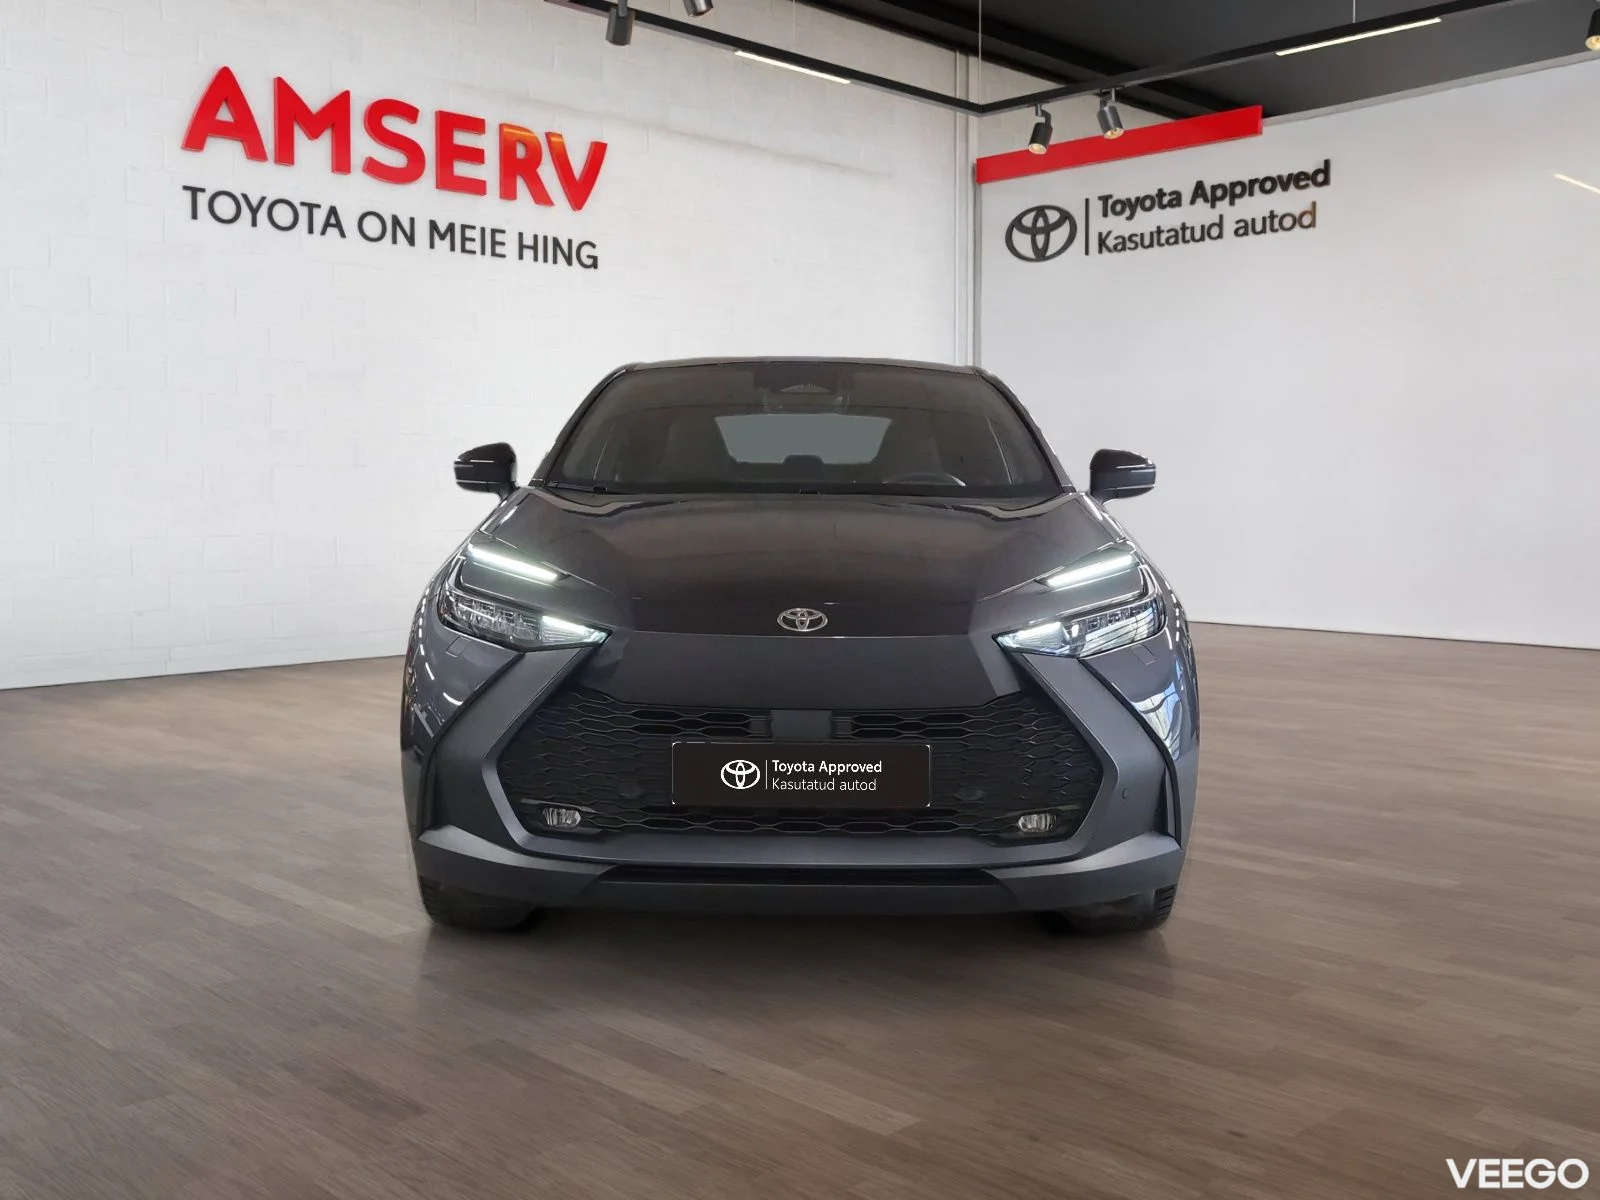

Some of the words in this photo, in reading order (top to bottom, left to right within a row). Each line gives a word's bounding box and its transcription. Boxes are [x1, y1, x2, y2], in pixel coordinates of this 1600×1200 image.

[181, 65, 608, 211] AMSERV
[1098, 187, 1182, 222] Toyota
[1189, 158, 1331, 207] Approved
[182, 185, 346, 239] TOYOTA
[357, 210, 416, 247] ON
[428, 219, 506, 259] MEIE
[518, 231, 599, 270] HING
[1097, 214, 1224, 255] Kasutatud
[1233, 201, 1317, 238] autod
[772, 760, 815, 775] Toyota
[818, 760, 882, 775] Approved
[772, 778, 835, 790] Kasutatud
[839, 778, 877, 790] autod
